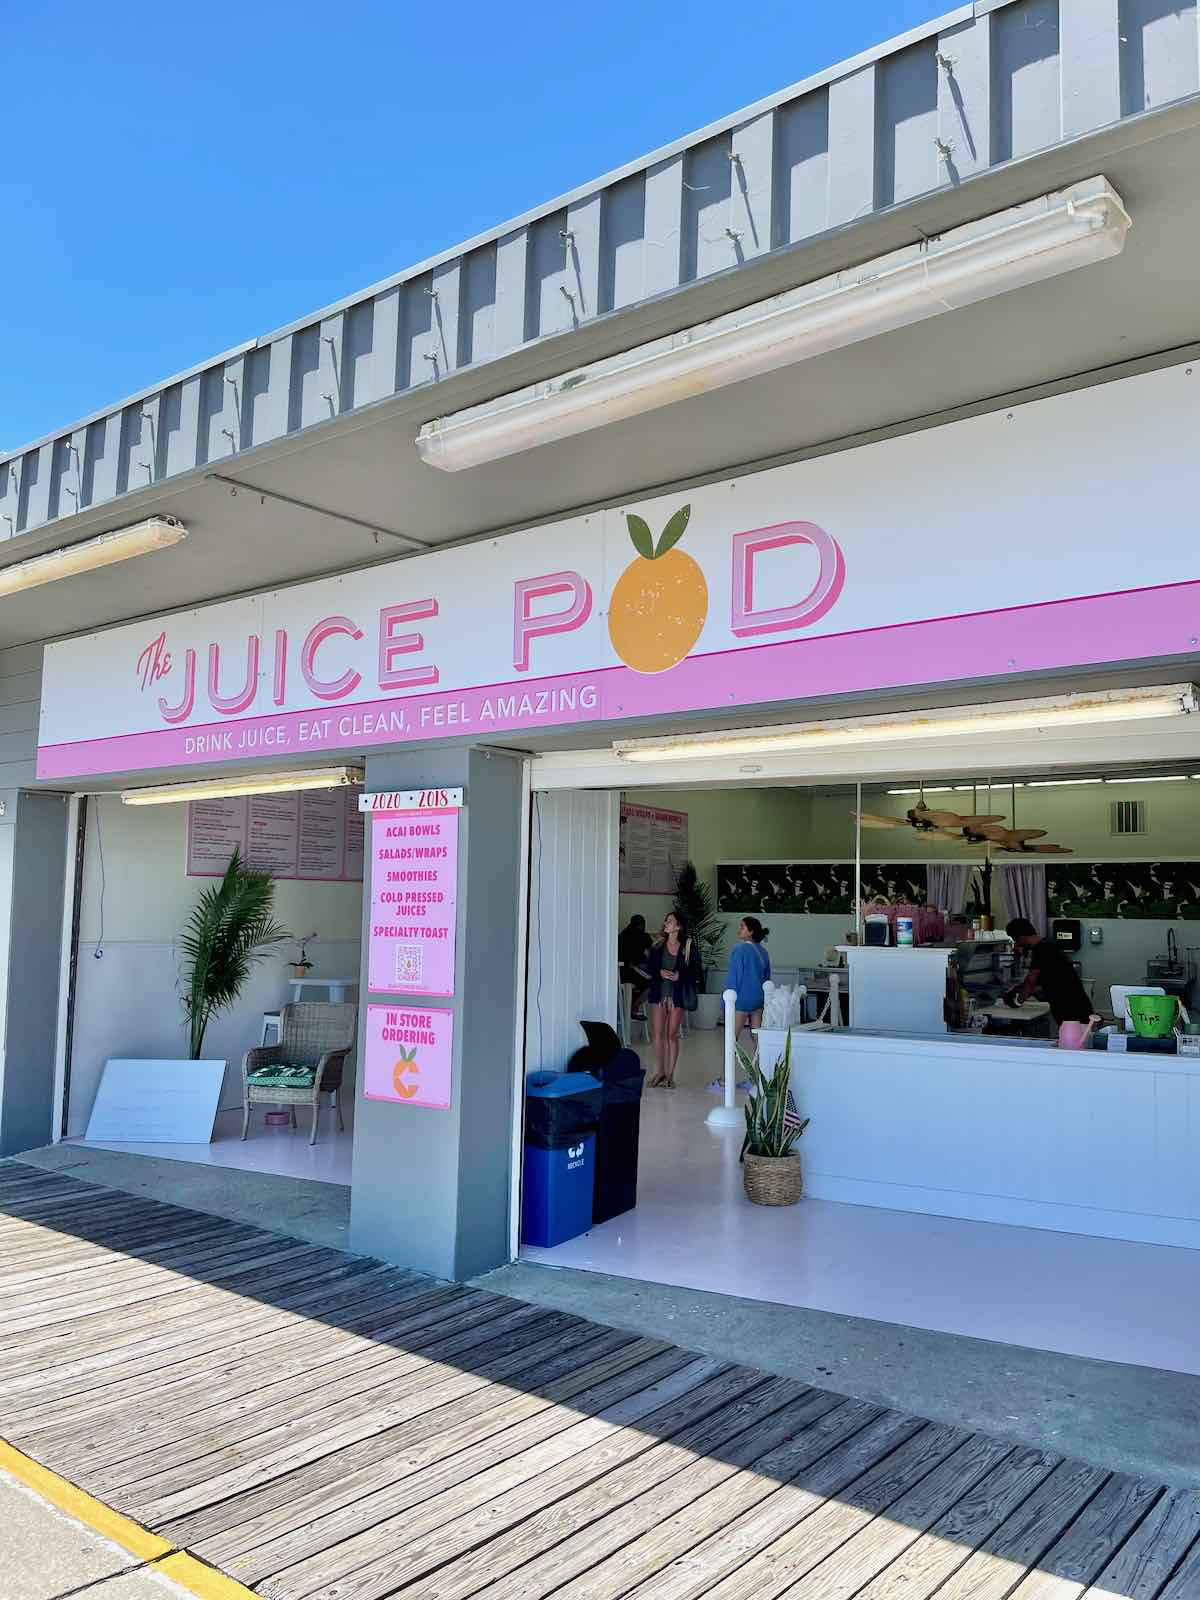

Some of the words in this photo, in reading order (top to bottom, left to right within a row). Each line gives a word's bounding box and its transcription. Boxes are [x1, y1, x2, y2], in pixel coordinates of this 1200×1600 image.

[136, 631, 172, 692] The
[159, 598, 440, 724] JUICE
[184, 733, 233, 755] DRINK
[237, 726, 291, 749] JUICE,
[299, 720, 333, 742] EAT
[338, 709, 411, 736] CLEAN,
[420, 699, 471, 729] FEEL
[479, 685, 598, 721] AMAZING
[372, 793, 401, 809] 2020
[418, 790, 449, 808] 2018
[385, 826, 407, 838] ACAI
[409, 824, 441, 837] BOWLS
[378, 846, 448, 860] SALADS/WRAPS
[387, 870, 438, 882] SMOOTHIES
[380, 892, 403, 903] COLD
[405, 892, 444, 903] PRESSED
[395, 905, 426, 916] JUICES
[373, 926, 419, 938] SPECIALTY
[420, 927, 449, 939] TOAST
[386, 1012, 397, 1027] IN
[399, 1013, 432, 1029] STORE
[382, 1028, 435, 1045] ORDERING
